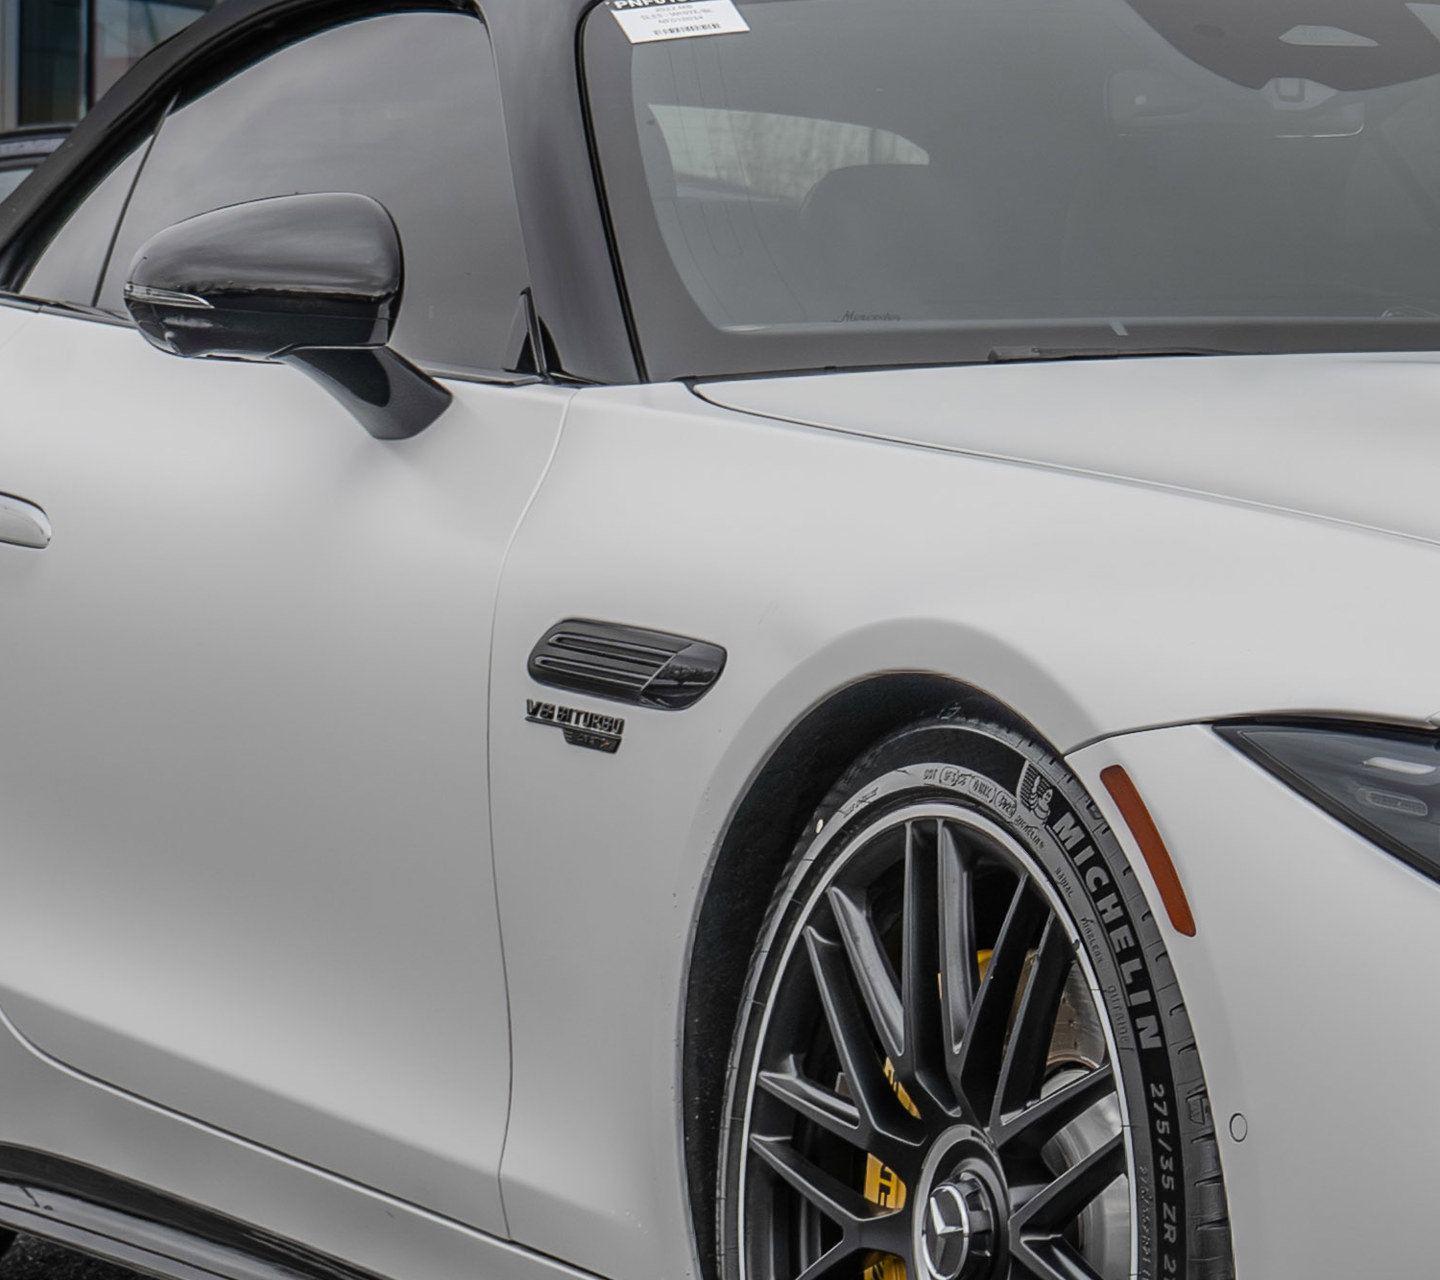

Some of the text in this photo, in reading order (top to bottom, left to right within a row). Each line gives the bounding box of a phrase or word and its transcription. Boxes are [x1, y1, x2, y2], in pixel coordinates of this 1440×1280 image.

[526, 699, 625, 734] V8 BITURBO
[1052, 811, 1163, 1050] MICHELIN
[1150, 1082, 1175, 1192] 275/35
[1162, 1201, 1178, 1245] ZR
